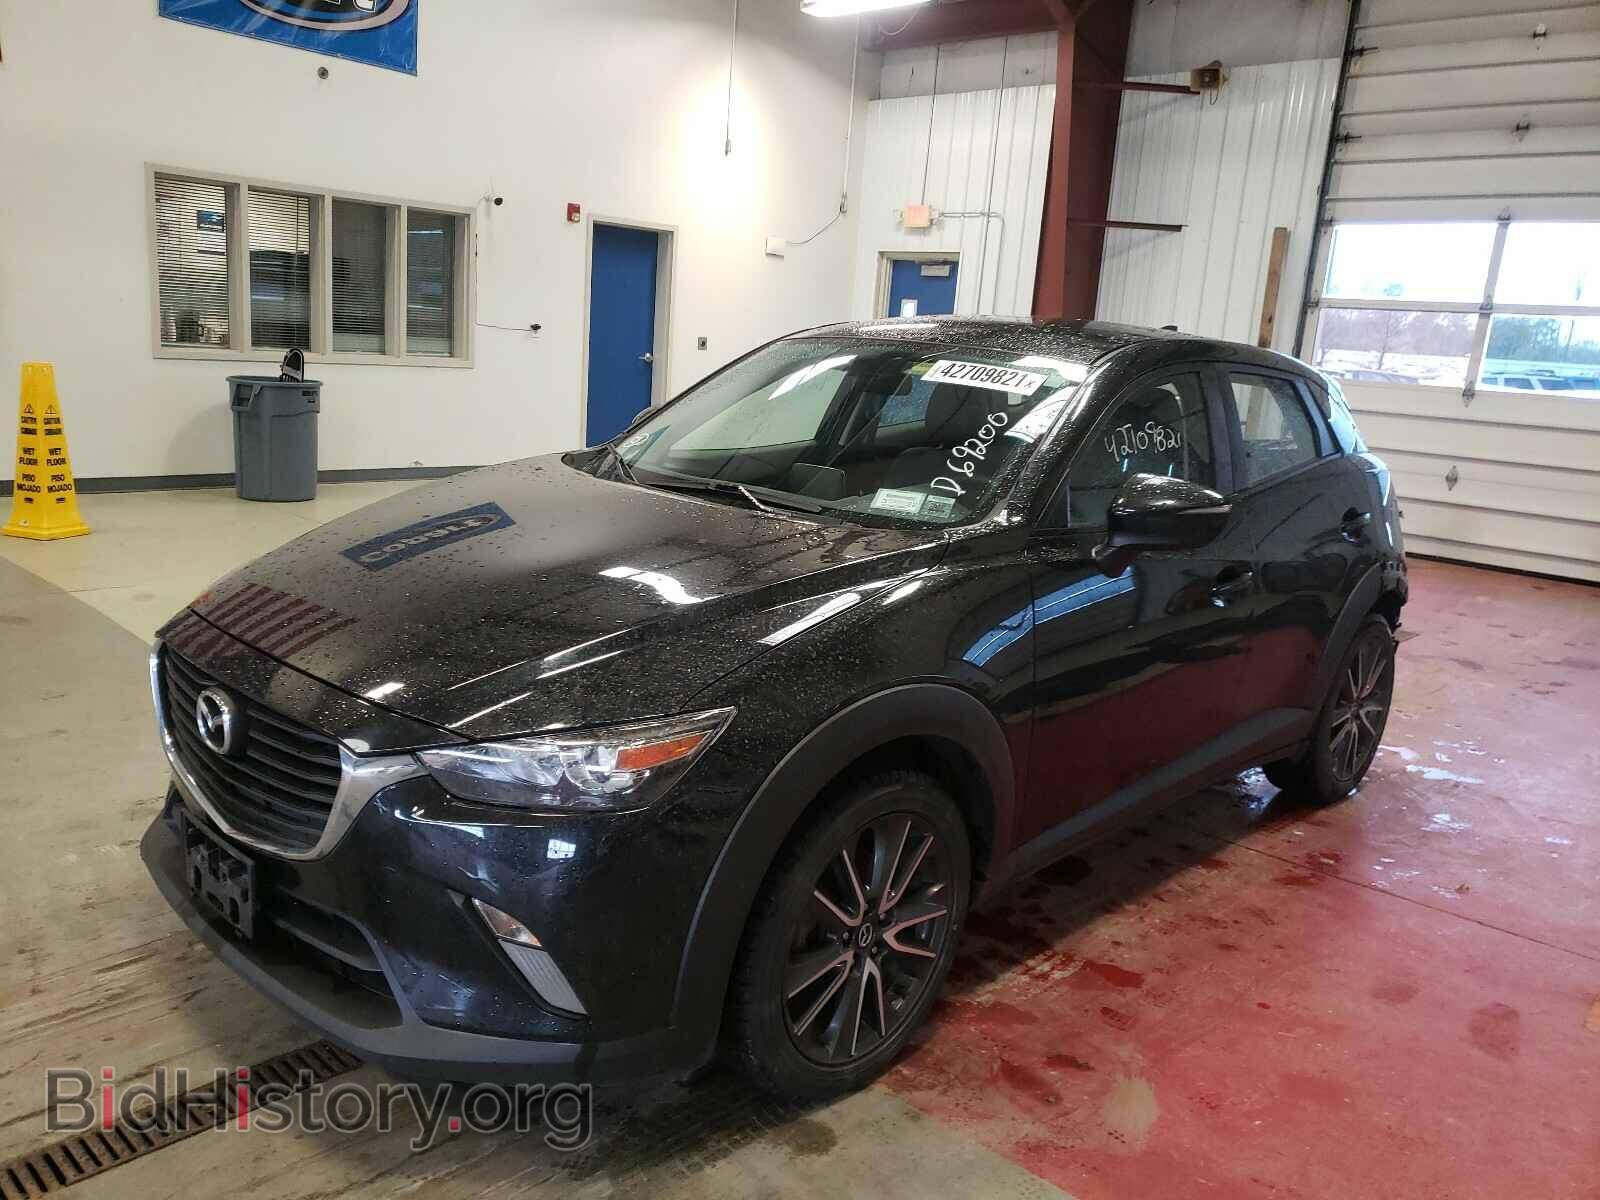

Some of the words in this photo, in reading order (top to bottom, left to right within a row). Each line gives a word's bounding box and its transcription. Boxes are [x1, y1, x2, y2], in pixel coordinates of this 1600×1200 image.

[940, 363, 1025, 388] 42709821
[48, 447, 61, 456] WET
[46, 457, 66, 466] FLOOR
